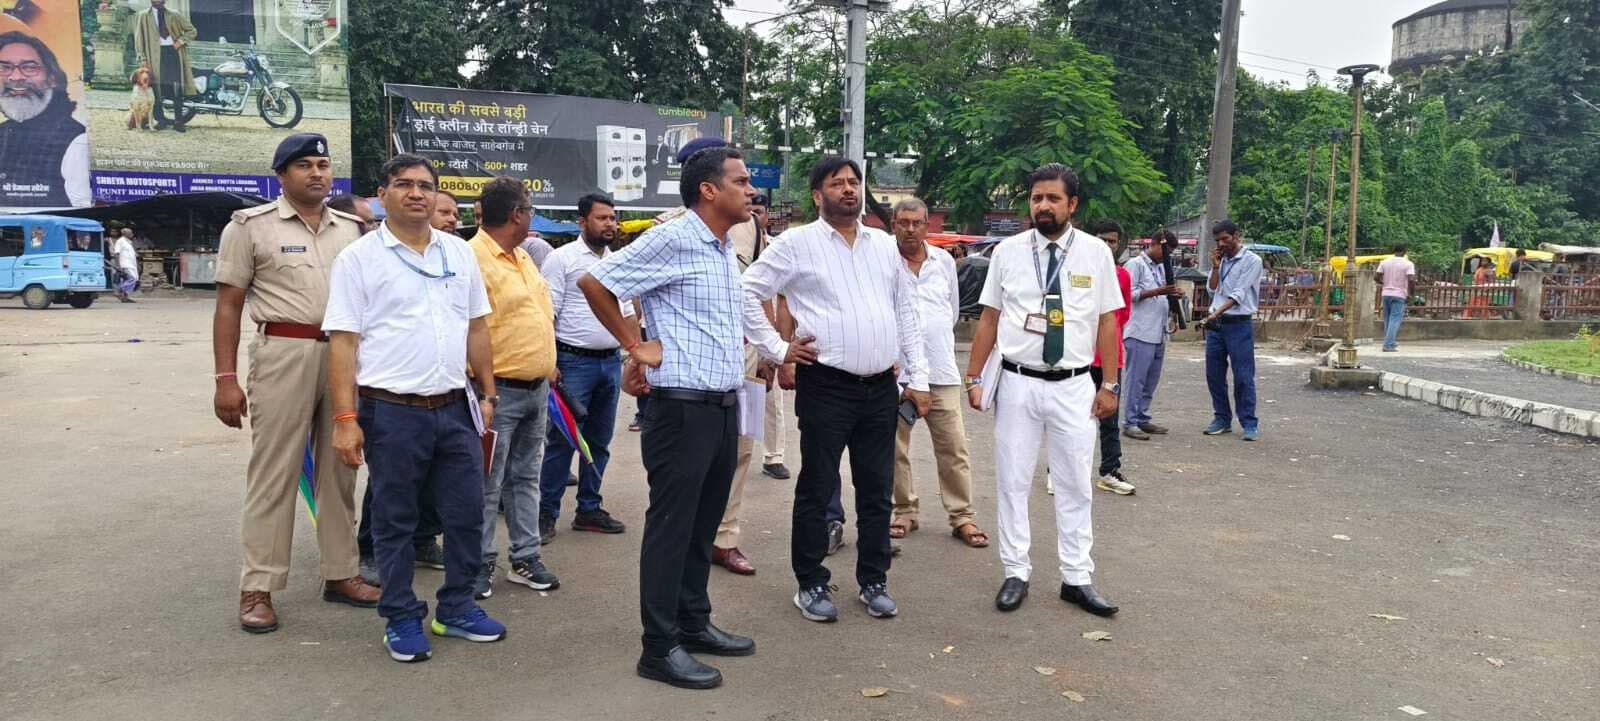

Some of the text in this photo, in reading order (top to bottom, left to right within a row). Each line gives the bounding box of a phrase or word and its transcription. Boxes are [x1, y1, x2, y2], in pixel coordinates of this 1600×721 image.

[412, 100, 527, 120] भारत की सबसे बड़ी
[658, 107, 706, 119] tumbledry
[413, 116, 435, 132] ड्राई
[439, 118, 469, 132] क्लीन
[472, 118, 495, 134] और
[530, 121, 549, 135] चेन
[510, 162, 529, 172] शहर
[96, 176, 177, 187] SHREYA MOTOSPORTS
